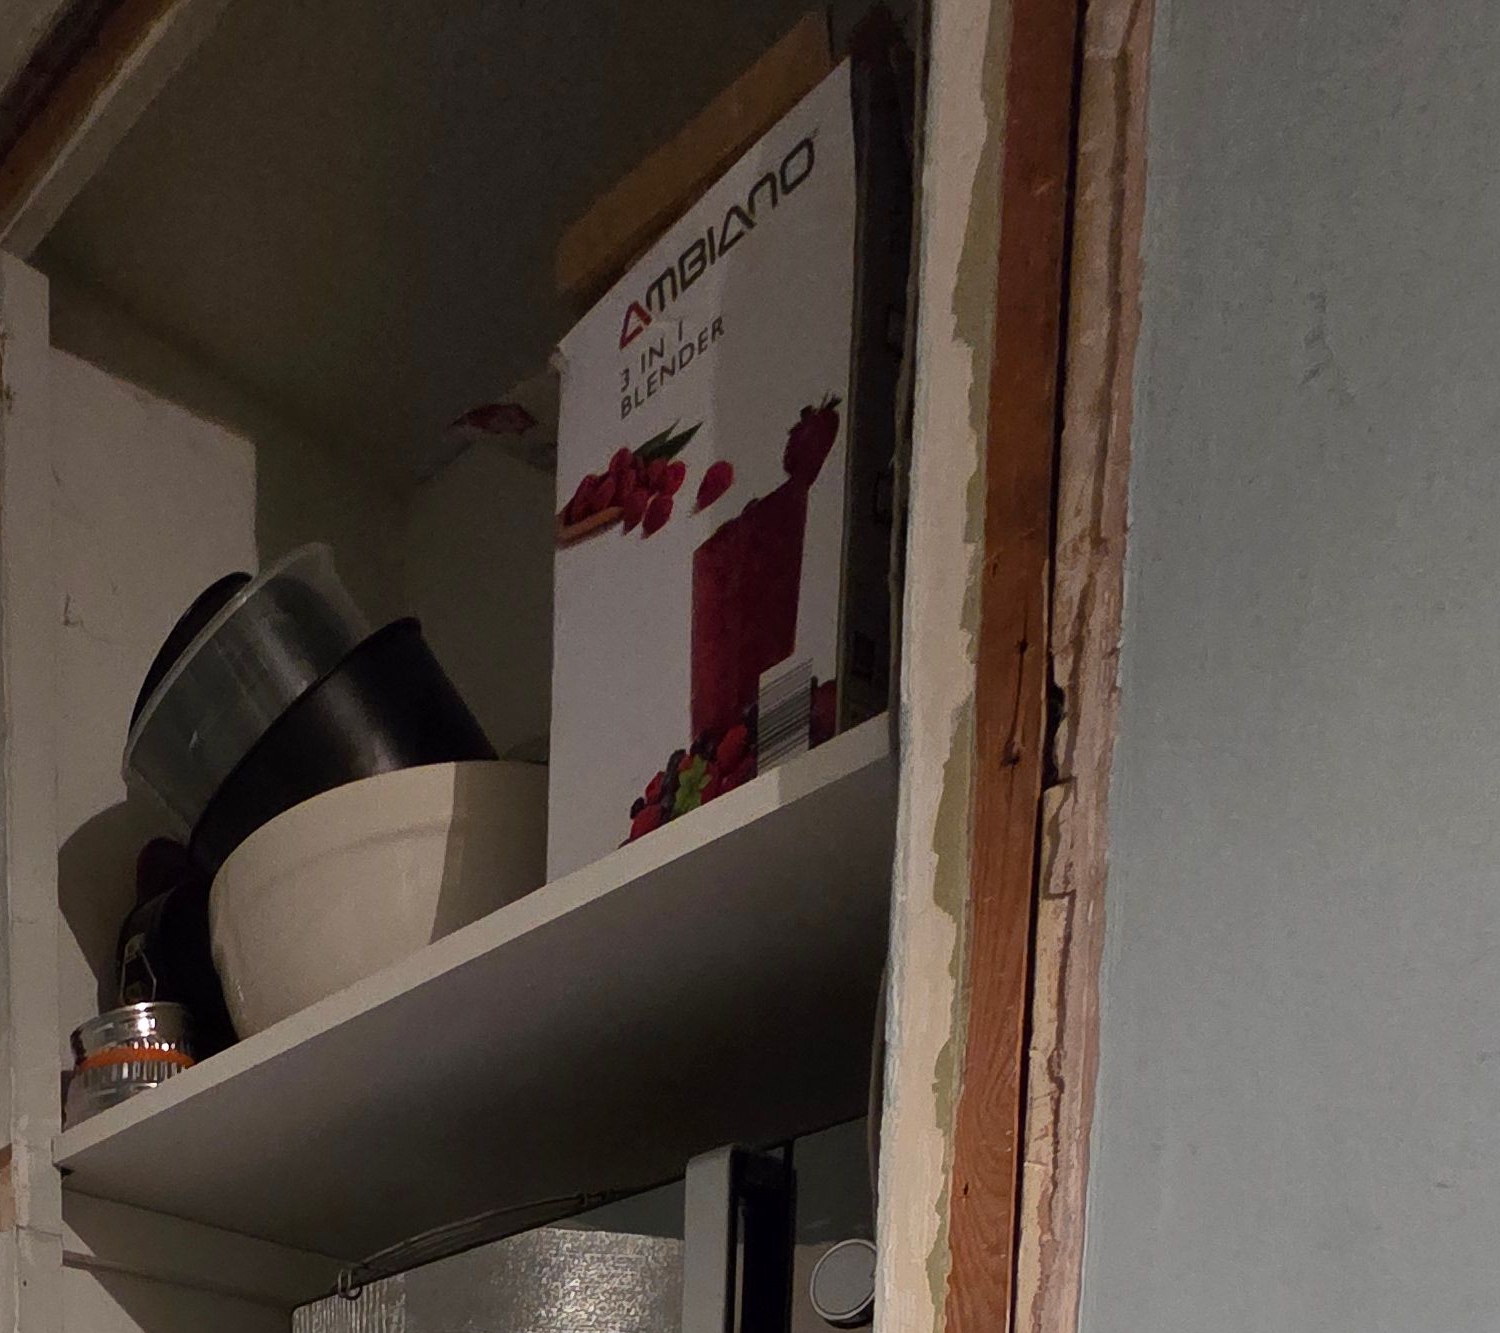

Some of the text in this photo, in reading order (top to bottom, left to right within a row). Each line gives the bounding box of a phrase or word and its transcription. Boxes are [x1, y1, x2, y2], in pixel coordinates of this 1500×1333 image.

[619, 136, 816, 349] AMBIANO
[620, 315, 725, 420] BLENDER
[640, 337, 665, 372] IN
